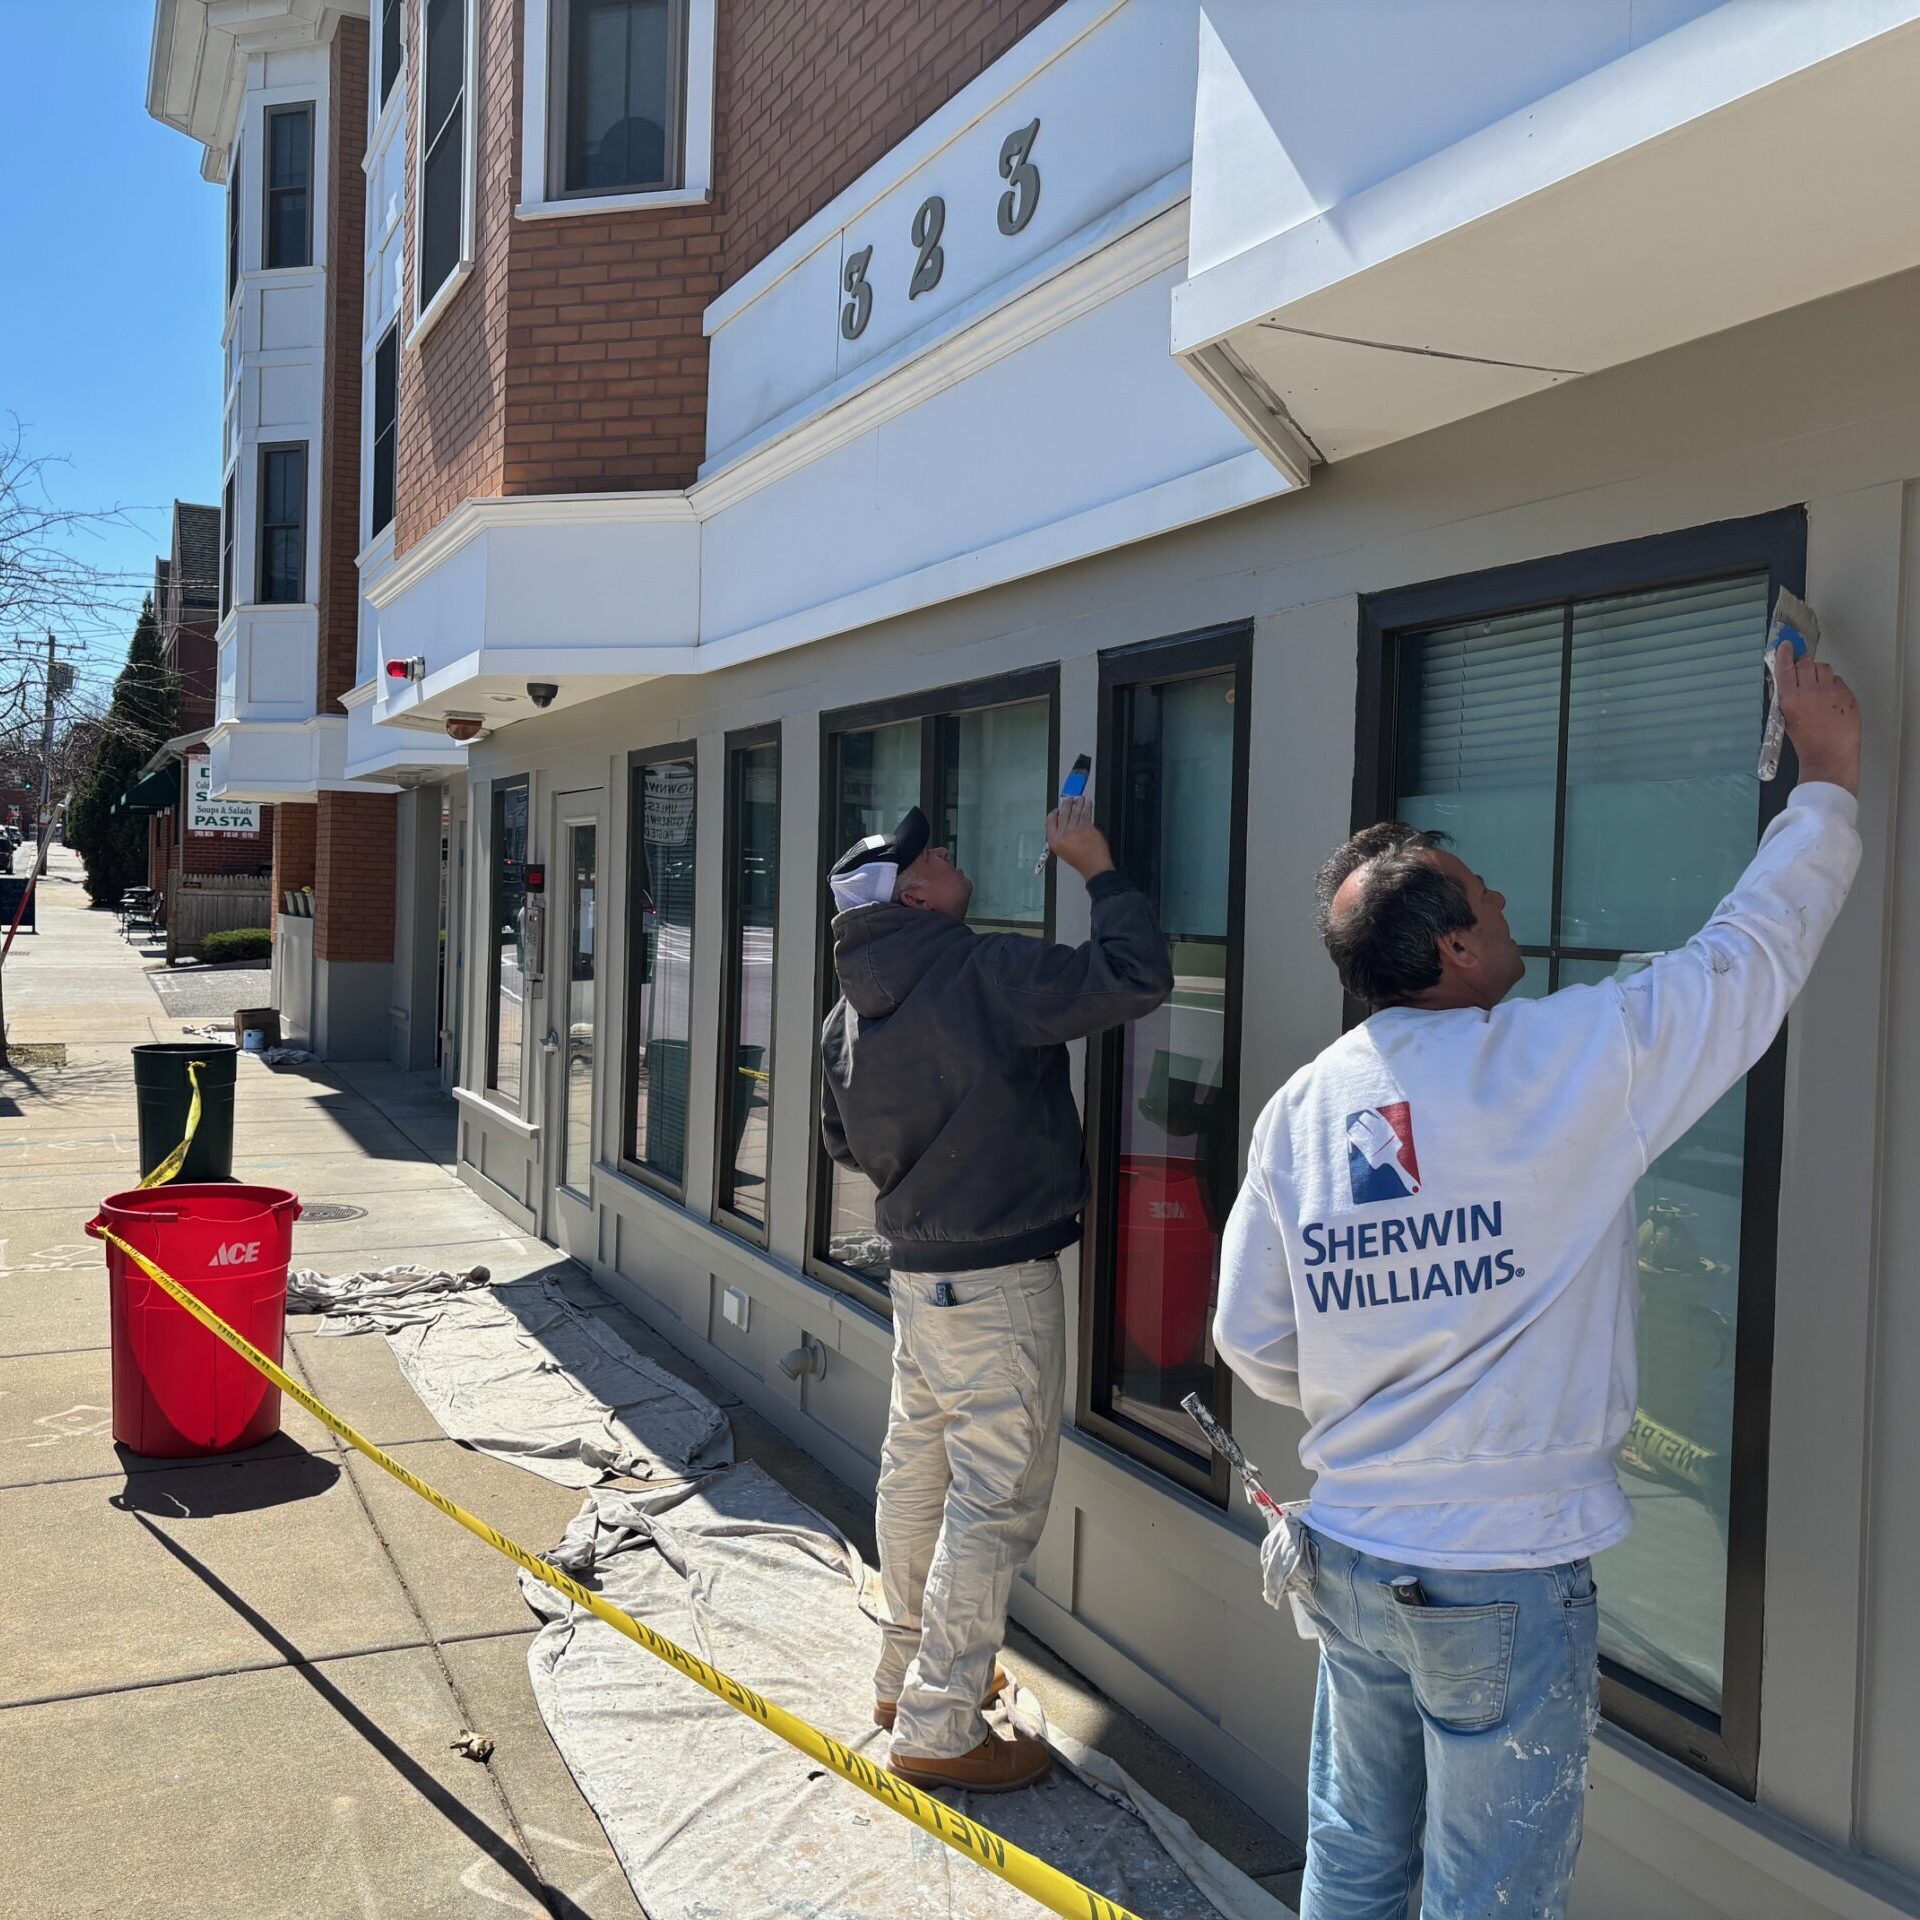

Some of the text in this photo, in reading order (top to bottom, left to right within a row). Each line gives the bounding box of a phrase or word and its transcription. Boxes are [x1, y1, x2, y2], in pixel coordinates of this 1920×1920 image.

[196, 805, 252, 815] Soups & Salads
[195, 816, 253, 827] PASTA
[1302, 1200, 1502, 1267] SHERWIN
[208, 1241, 261, 1267] ACE
